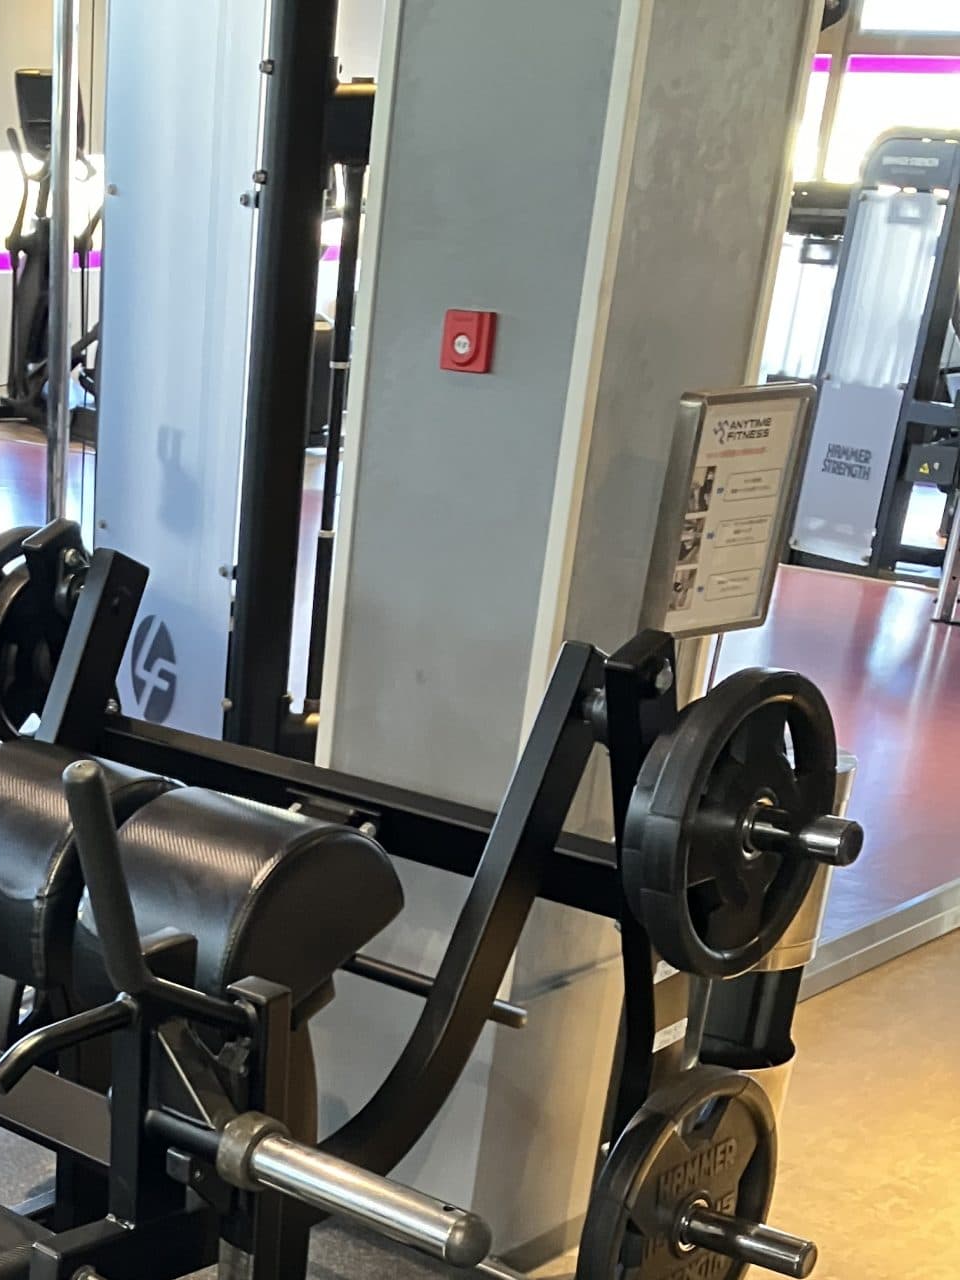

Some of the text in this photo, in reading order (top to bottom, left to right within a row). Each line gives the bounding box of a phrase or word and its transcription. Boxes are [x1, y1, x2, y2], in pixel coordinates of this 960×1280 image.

[726, 429, 770, 441] FITNESS
[729, 418, 772, 431] ANYTIME
[826, 443, 871, 464] HAMMER
[822, 458, 871, 480] STRENGTH
[655, 1137, 738, 1208] HAMMER
